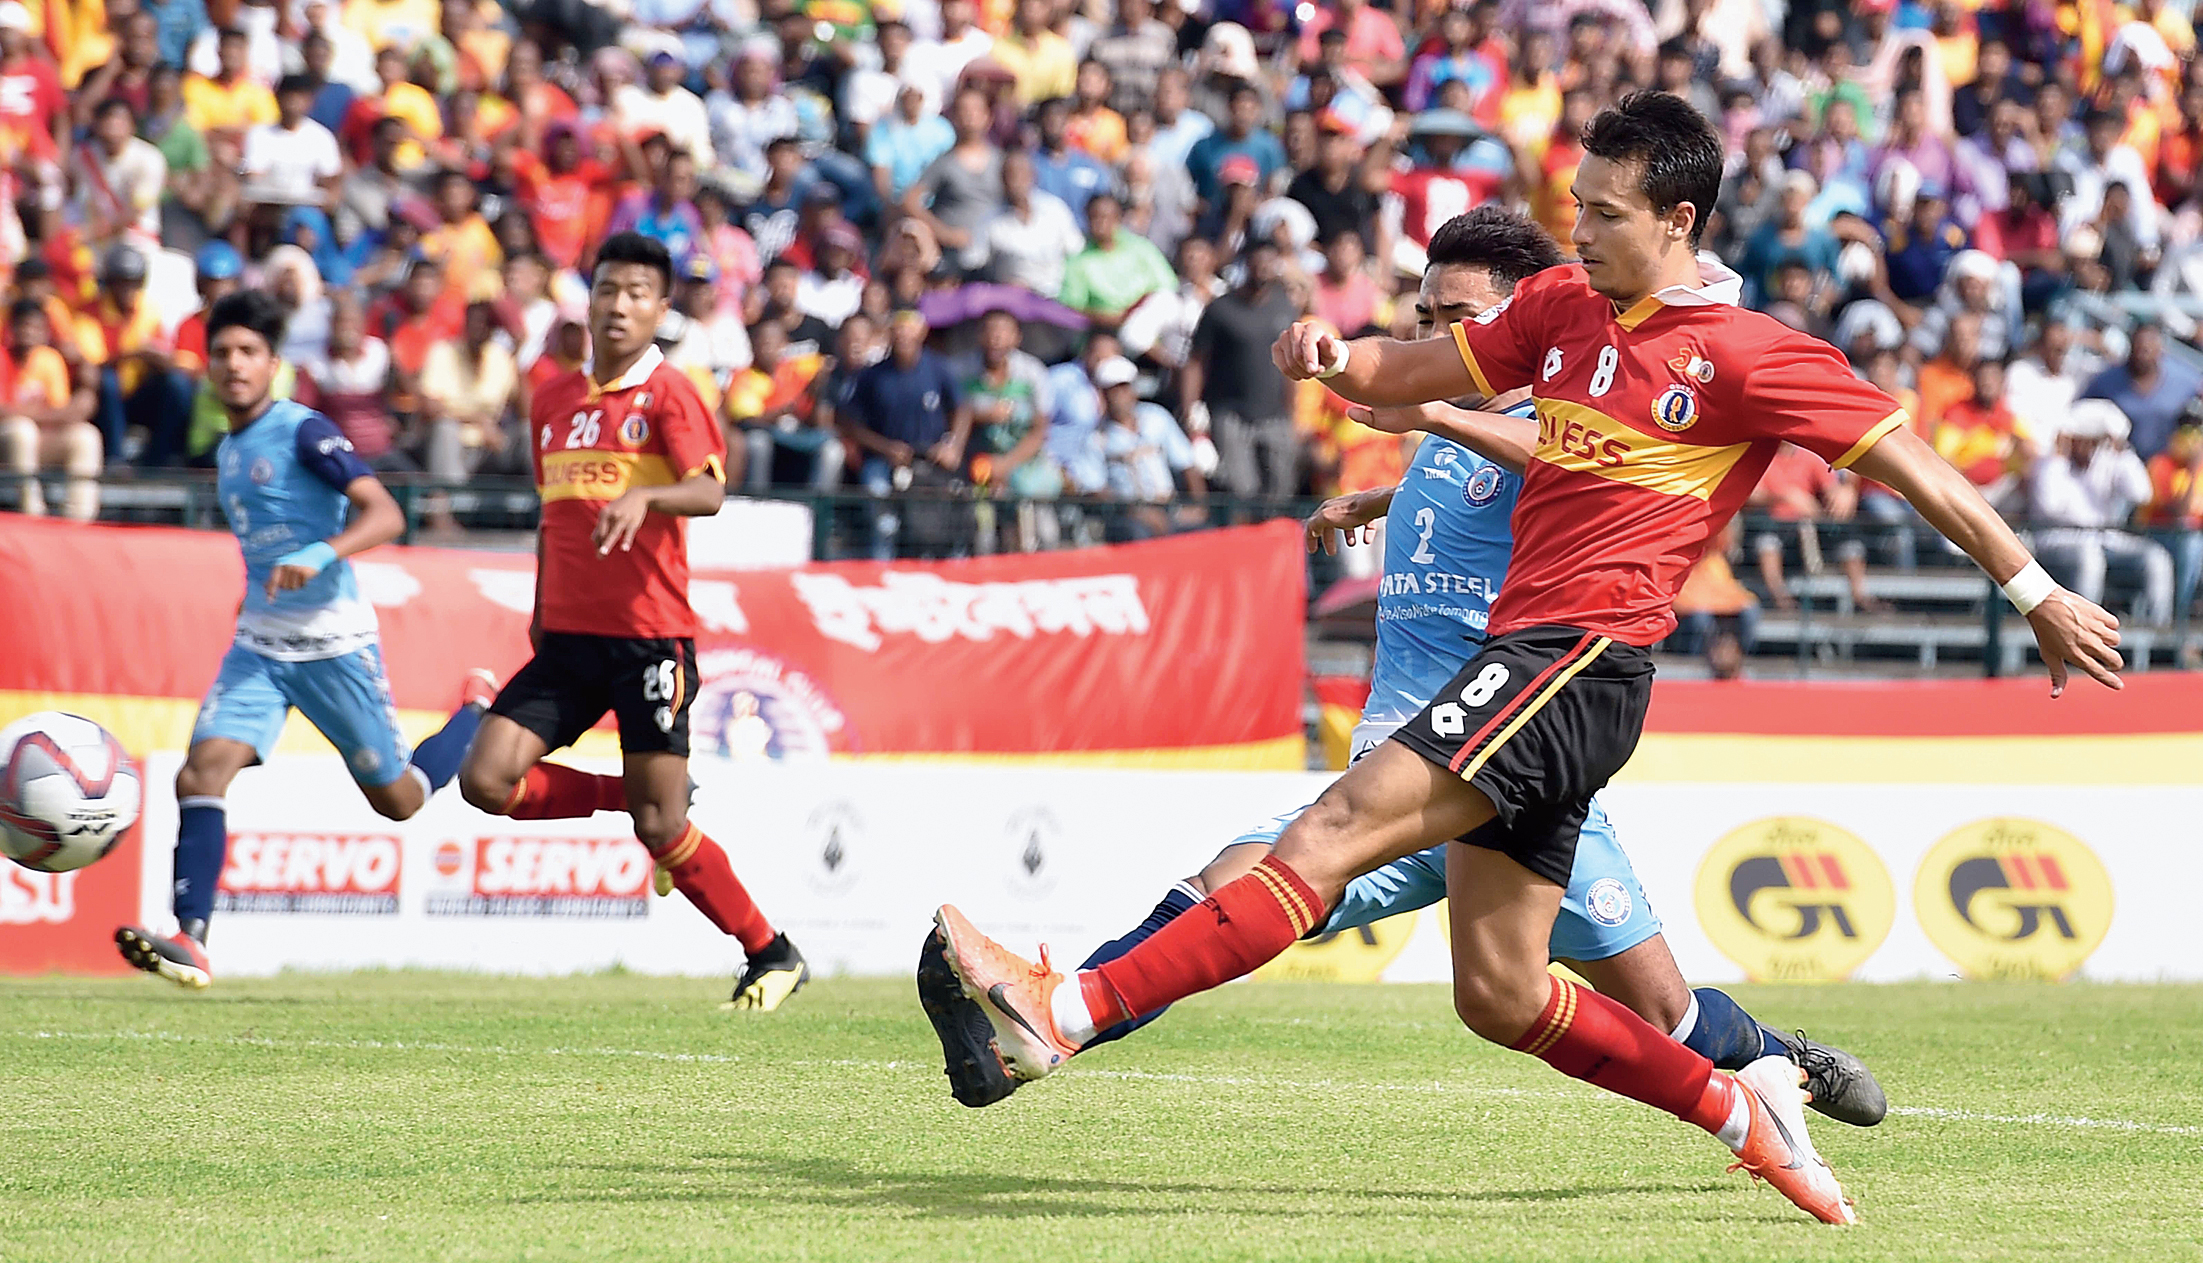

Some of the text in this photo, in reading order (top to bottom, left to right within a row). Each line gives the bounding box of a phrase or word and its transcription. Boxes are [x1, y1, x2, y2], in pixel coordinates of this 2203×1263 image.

[1588, 344, 1619, 397] 8
[565, 410, 605, 449] 26
[1410, 507, 1436, 564] 2
[1424, 572, 1499, 605] STEEL
[642, 659, 677, 701] 26
[1460, 661, 1511, 708] 8
[225, 836, 398, 890] SERVO
[478, 838, 650, 894] SERVO
